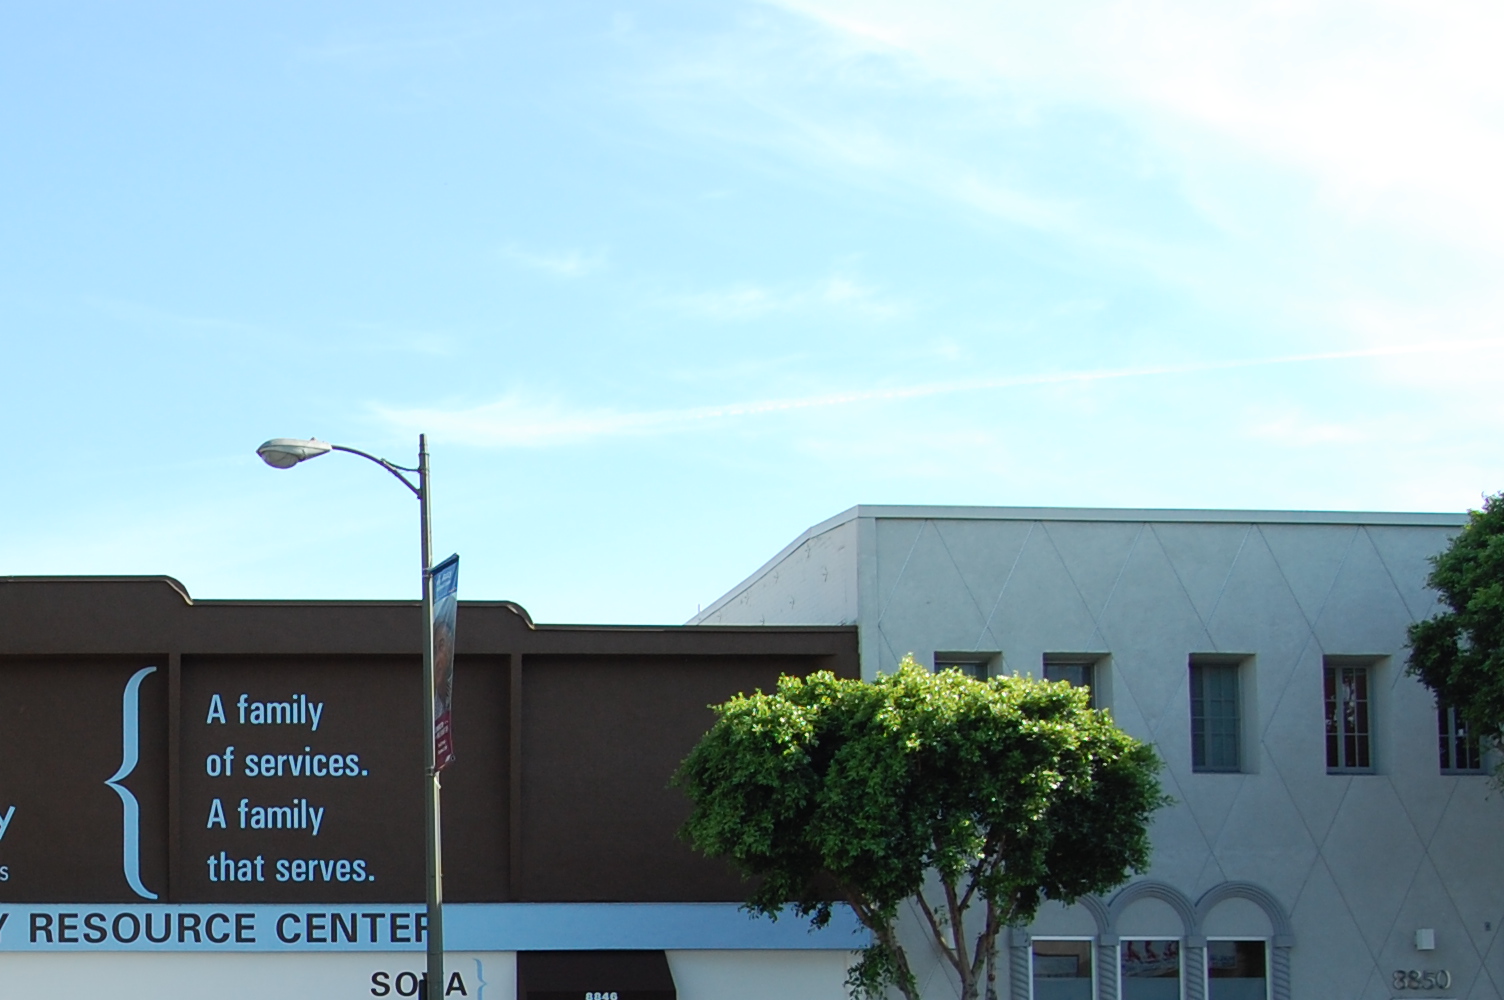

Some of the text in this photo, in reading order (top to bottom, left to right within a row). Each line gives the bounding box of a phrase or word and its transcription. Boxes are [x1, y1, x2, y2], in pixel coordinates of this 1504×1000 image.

[206, 693, 324, 731] A family
[206, 746, 368, 776] of services.
[207, 798, 324, 836] A family
[207, 851, 375, 882] that serves.
[29, 912, 256, 943] RESOURCE
[370, 971, 468, 996] SOA
[1393, 970, 1451, 990] 8850
